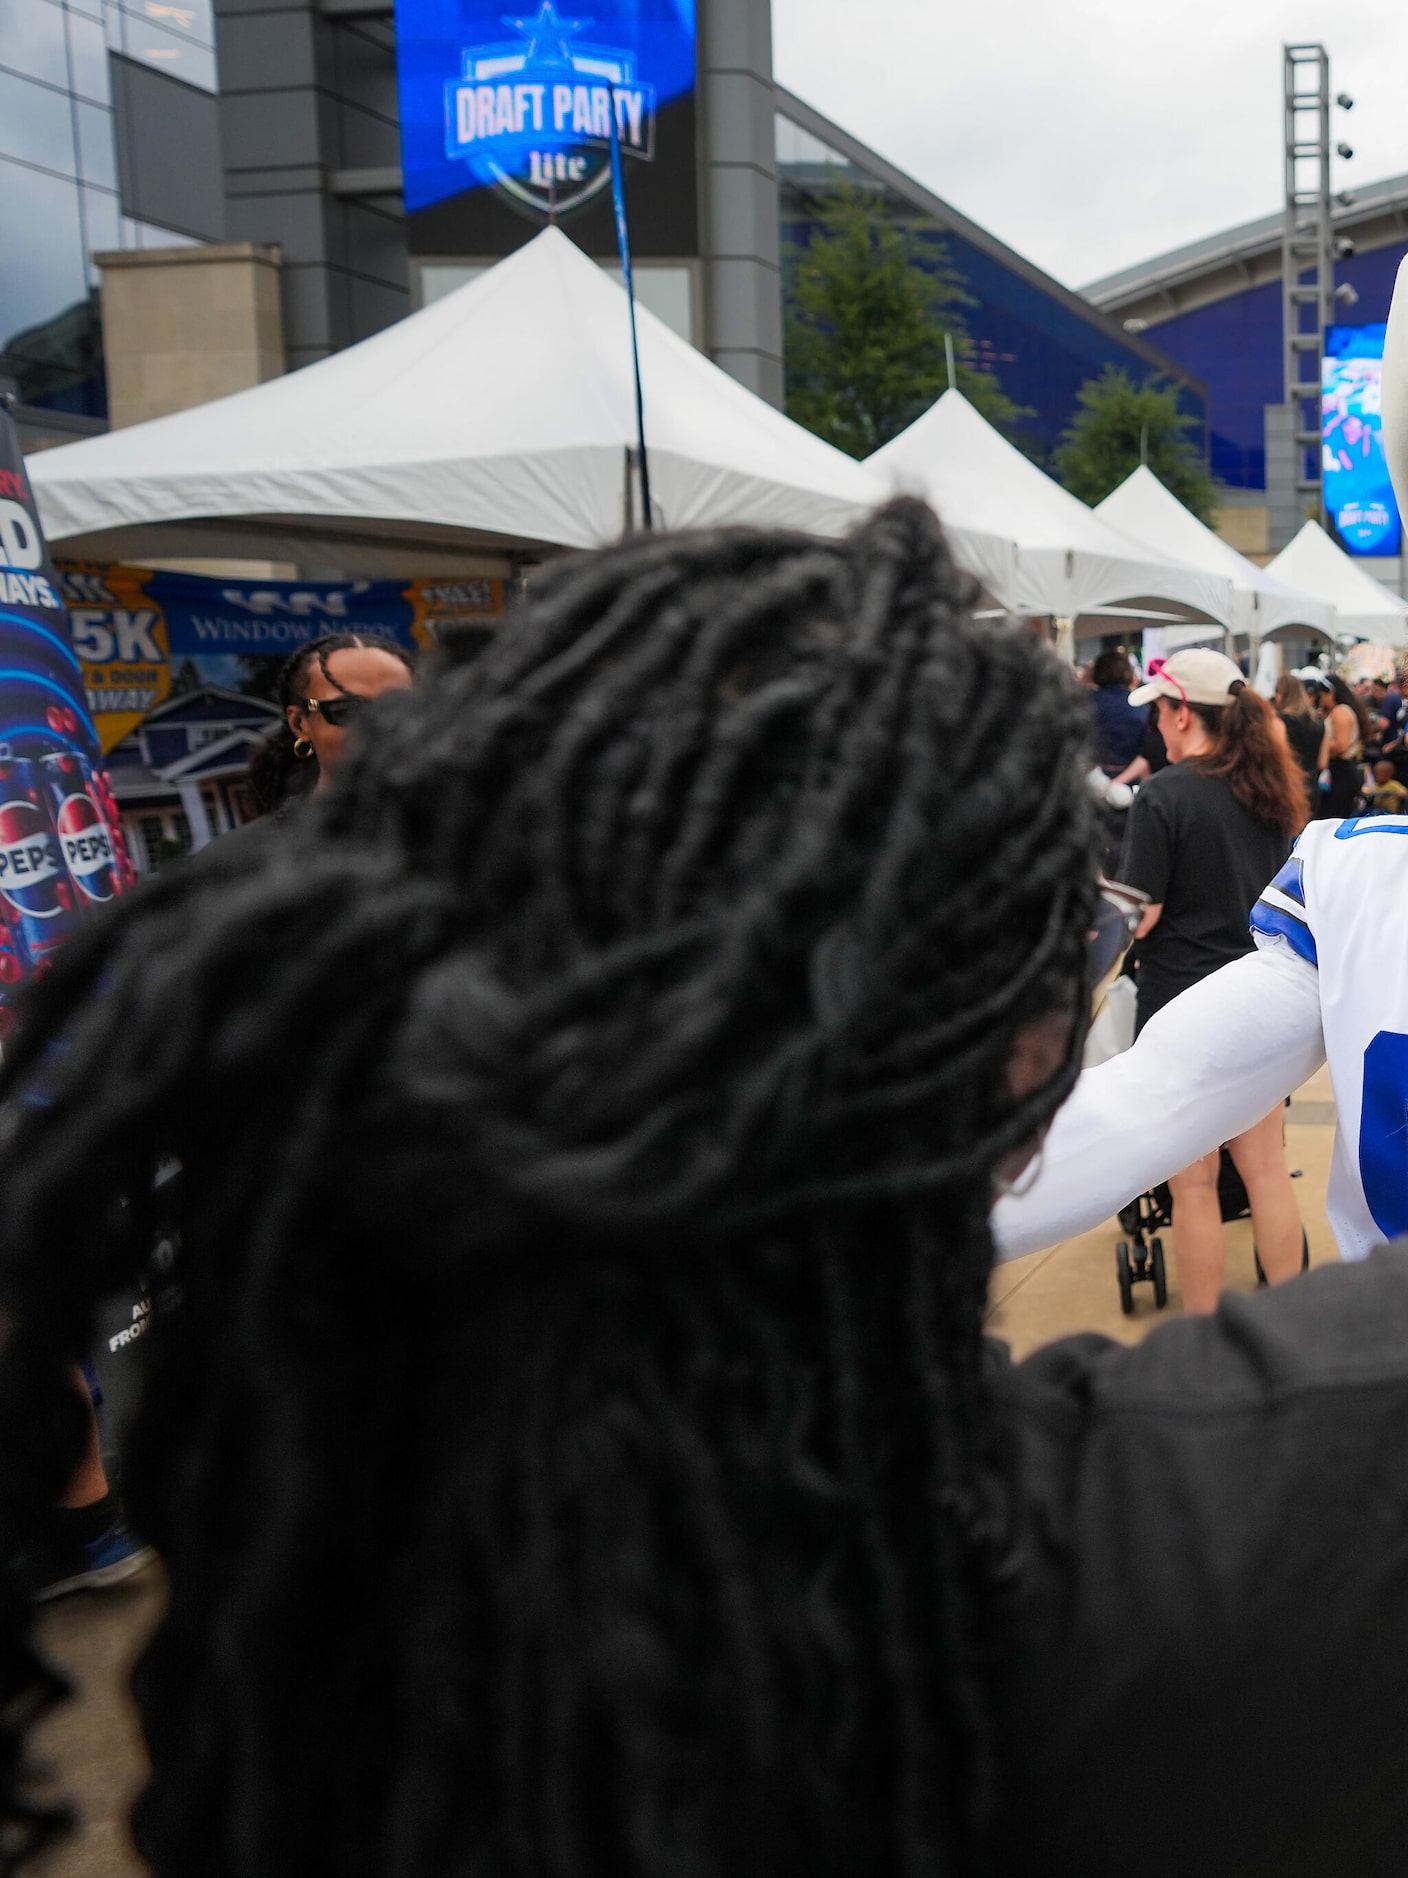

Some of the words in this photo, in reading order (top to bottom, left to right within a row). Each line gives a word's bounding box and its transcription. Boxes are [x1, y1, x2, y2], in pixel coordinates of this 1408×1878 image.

[456, 84, 545, 144] DRAFT
[552, 84, 642, 147] PARTY
[529, 151, 587, 188] Lite
